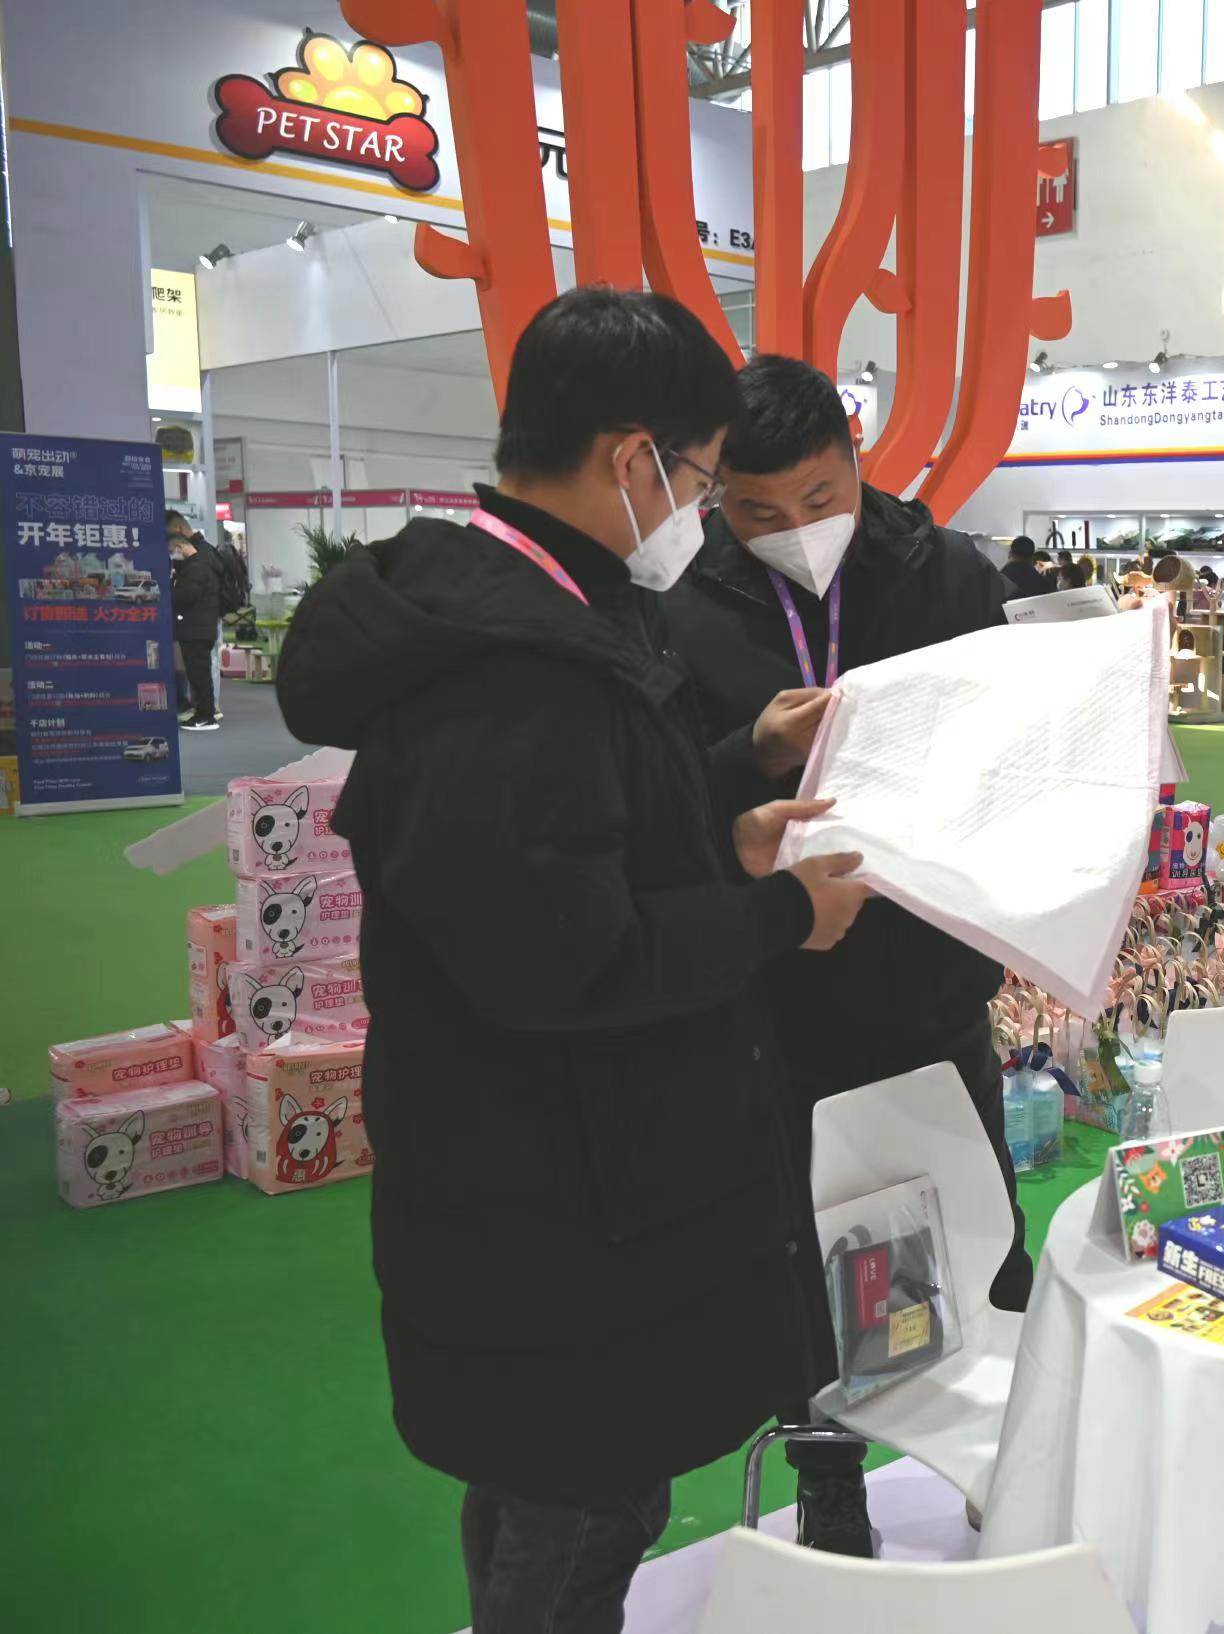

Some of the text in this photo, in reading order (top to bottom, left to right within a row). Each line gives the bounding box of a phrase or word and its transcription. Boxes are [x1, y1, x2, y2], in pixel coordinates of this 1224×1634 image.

[257, 107, 406, 163] PET STAR
[730, 229, 755, 249] E3
[320, 891, 363, 909] 宠物训
[311, 979, 358, 999] 宠物训
